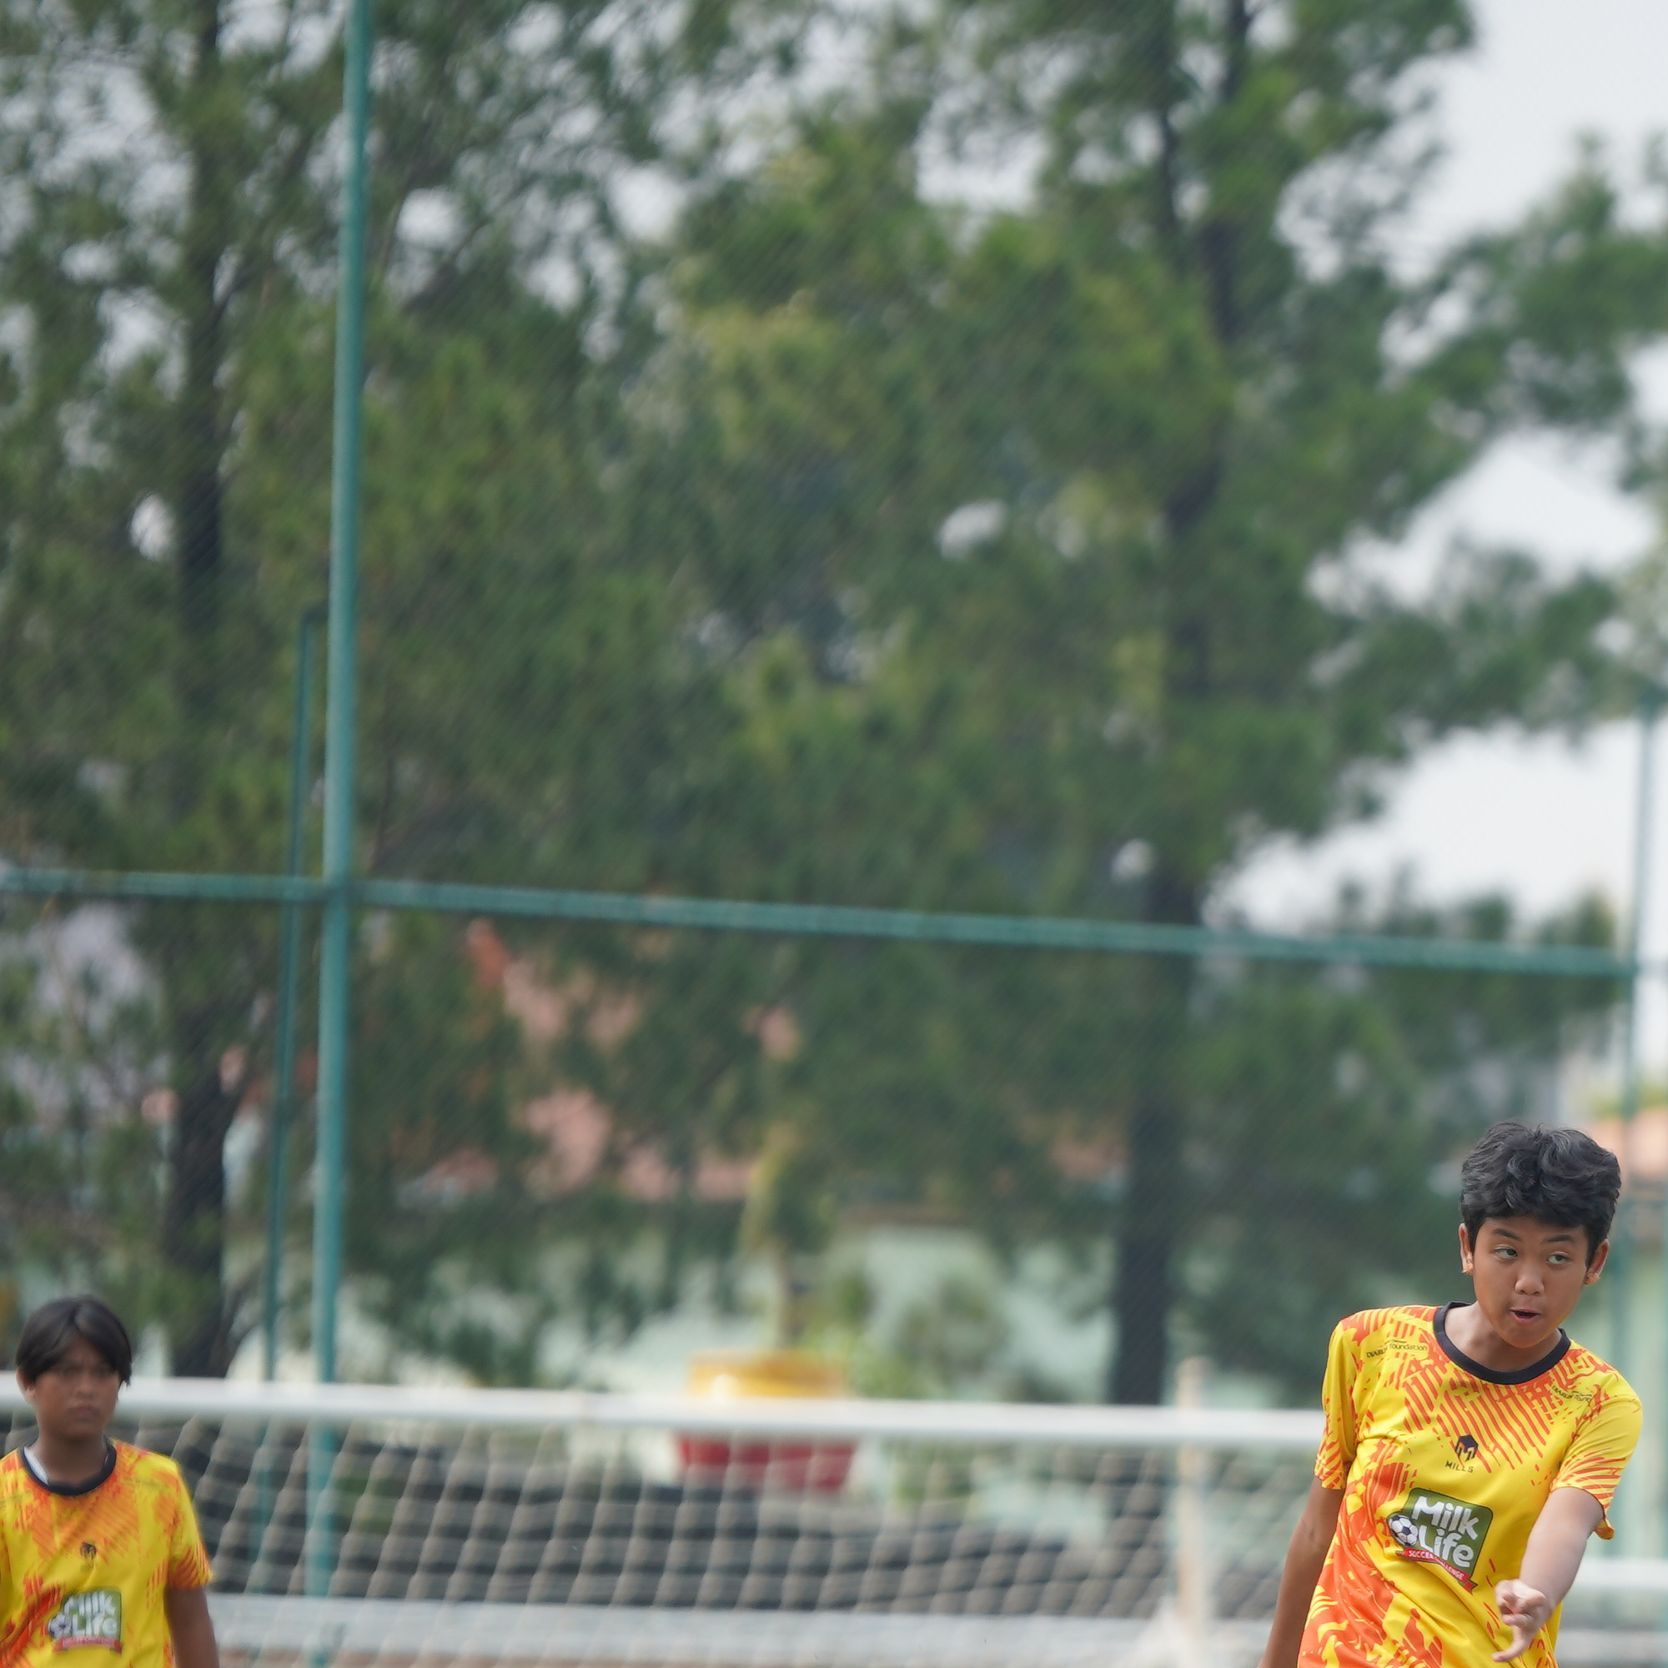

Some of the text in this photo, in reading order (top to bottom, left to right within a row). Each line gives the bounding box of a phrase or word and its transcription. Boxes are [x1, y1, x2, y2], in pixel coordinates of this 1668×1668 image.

[1445, 1460, 1474, 1473] MILLS
[1411, 1495, 1479, 1540] Milk
[1418, 1524, 1474, 1568] Life
[72, 1612, 118, 1637] Life
